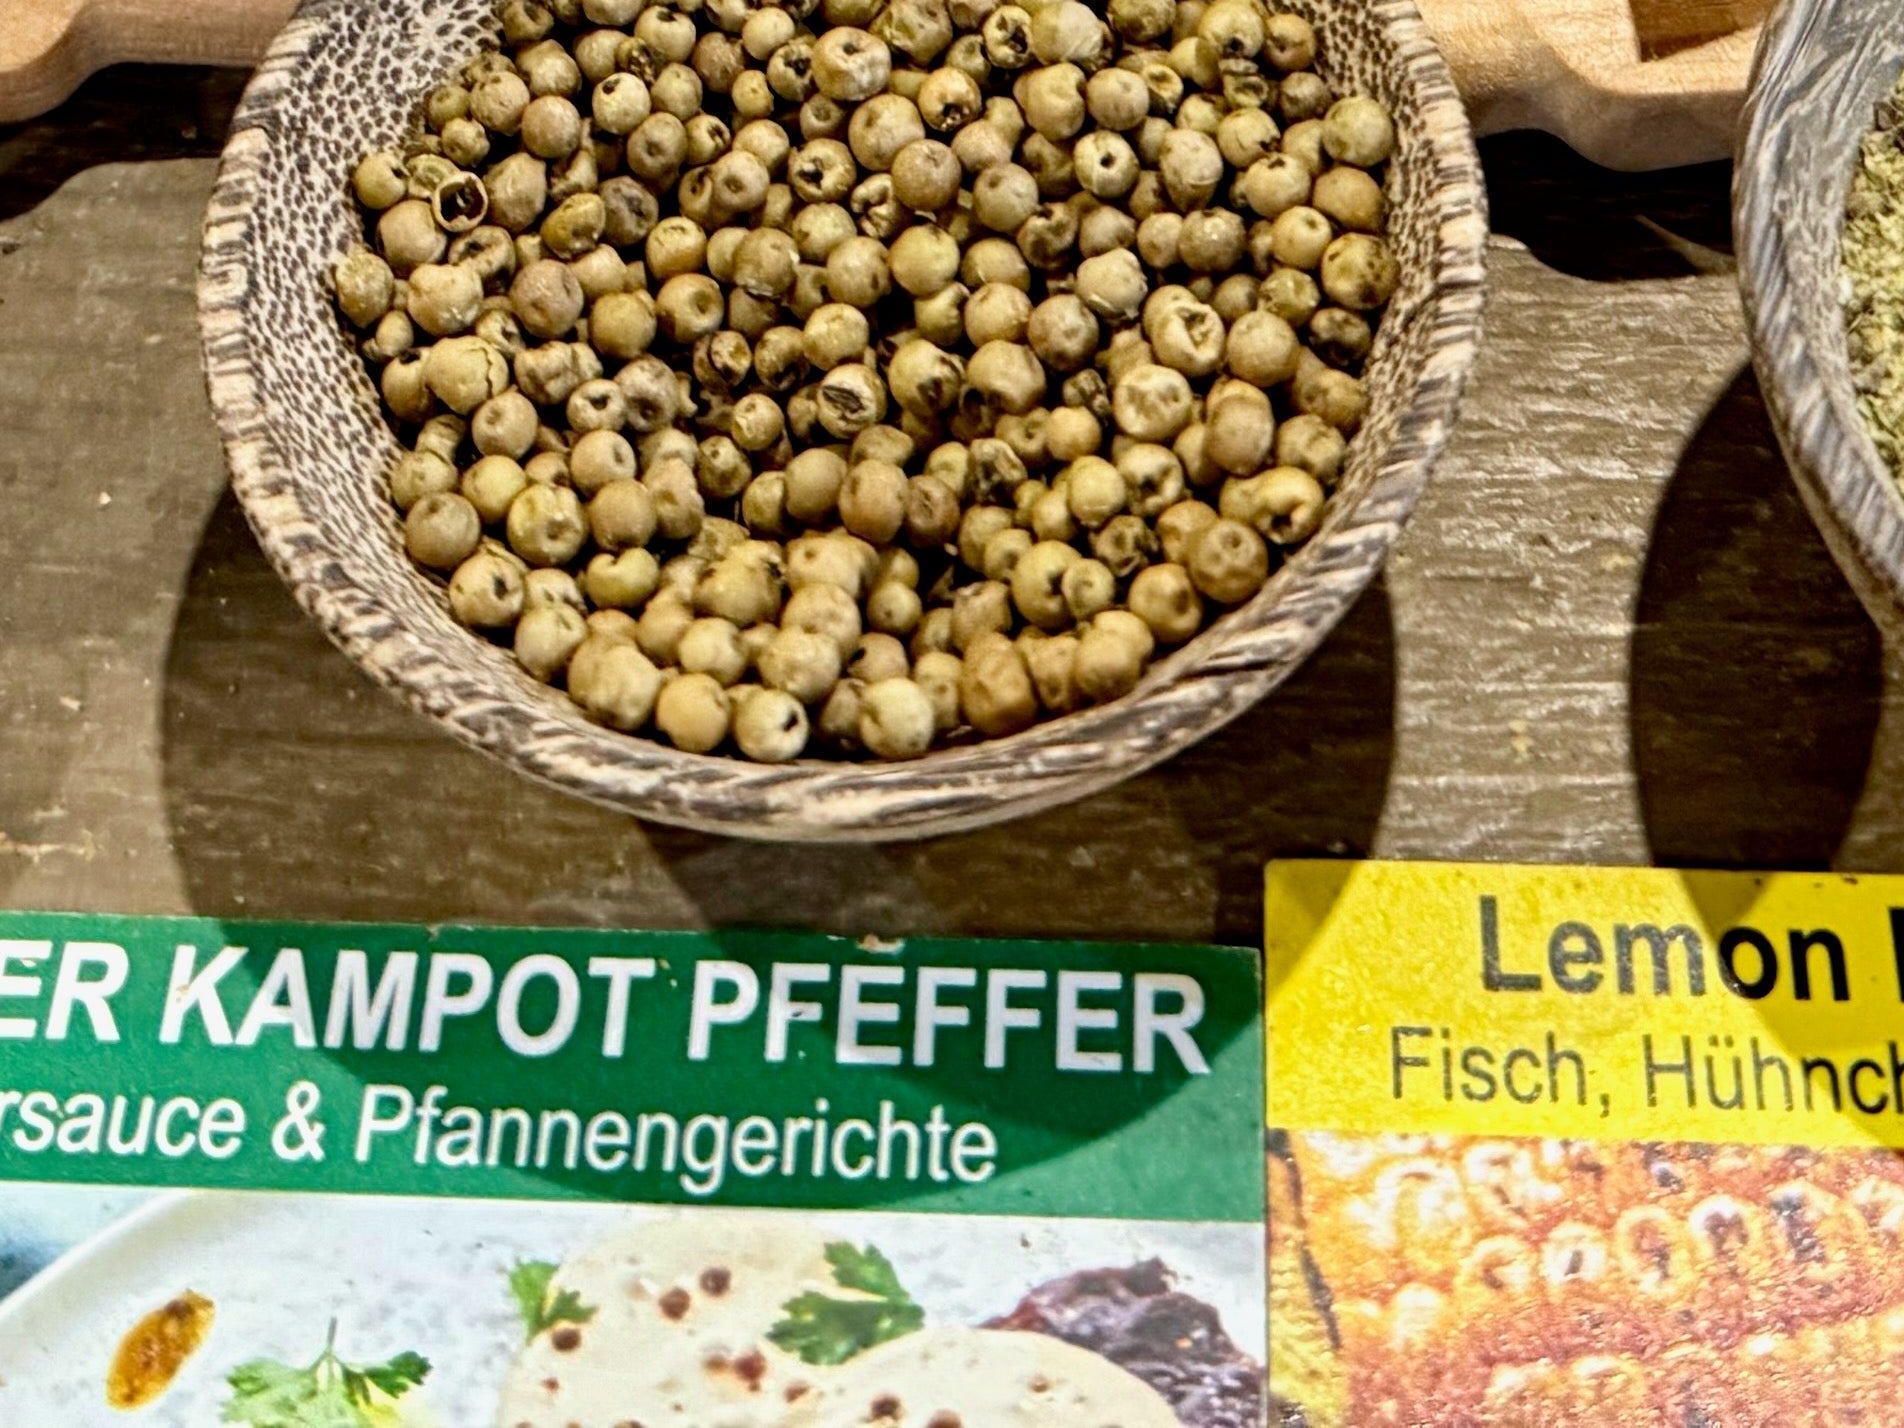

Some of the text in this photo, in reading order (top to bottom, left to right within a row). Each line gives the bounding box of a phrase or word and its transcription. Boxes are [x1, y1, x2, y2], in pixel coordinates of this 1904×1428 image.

[1478, 894, 1853, 1004] Lemon
[159, 945, 656, 1059] KAMPOT
[687, 957, 1213, 1076] PFEFFER
[1389, 1024, 1614, 1119] Fisch,
[271, 1081, 328, 1164] &
[355, 1083, 998, 1196] Pfannengerichte
